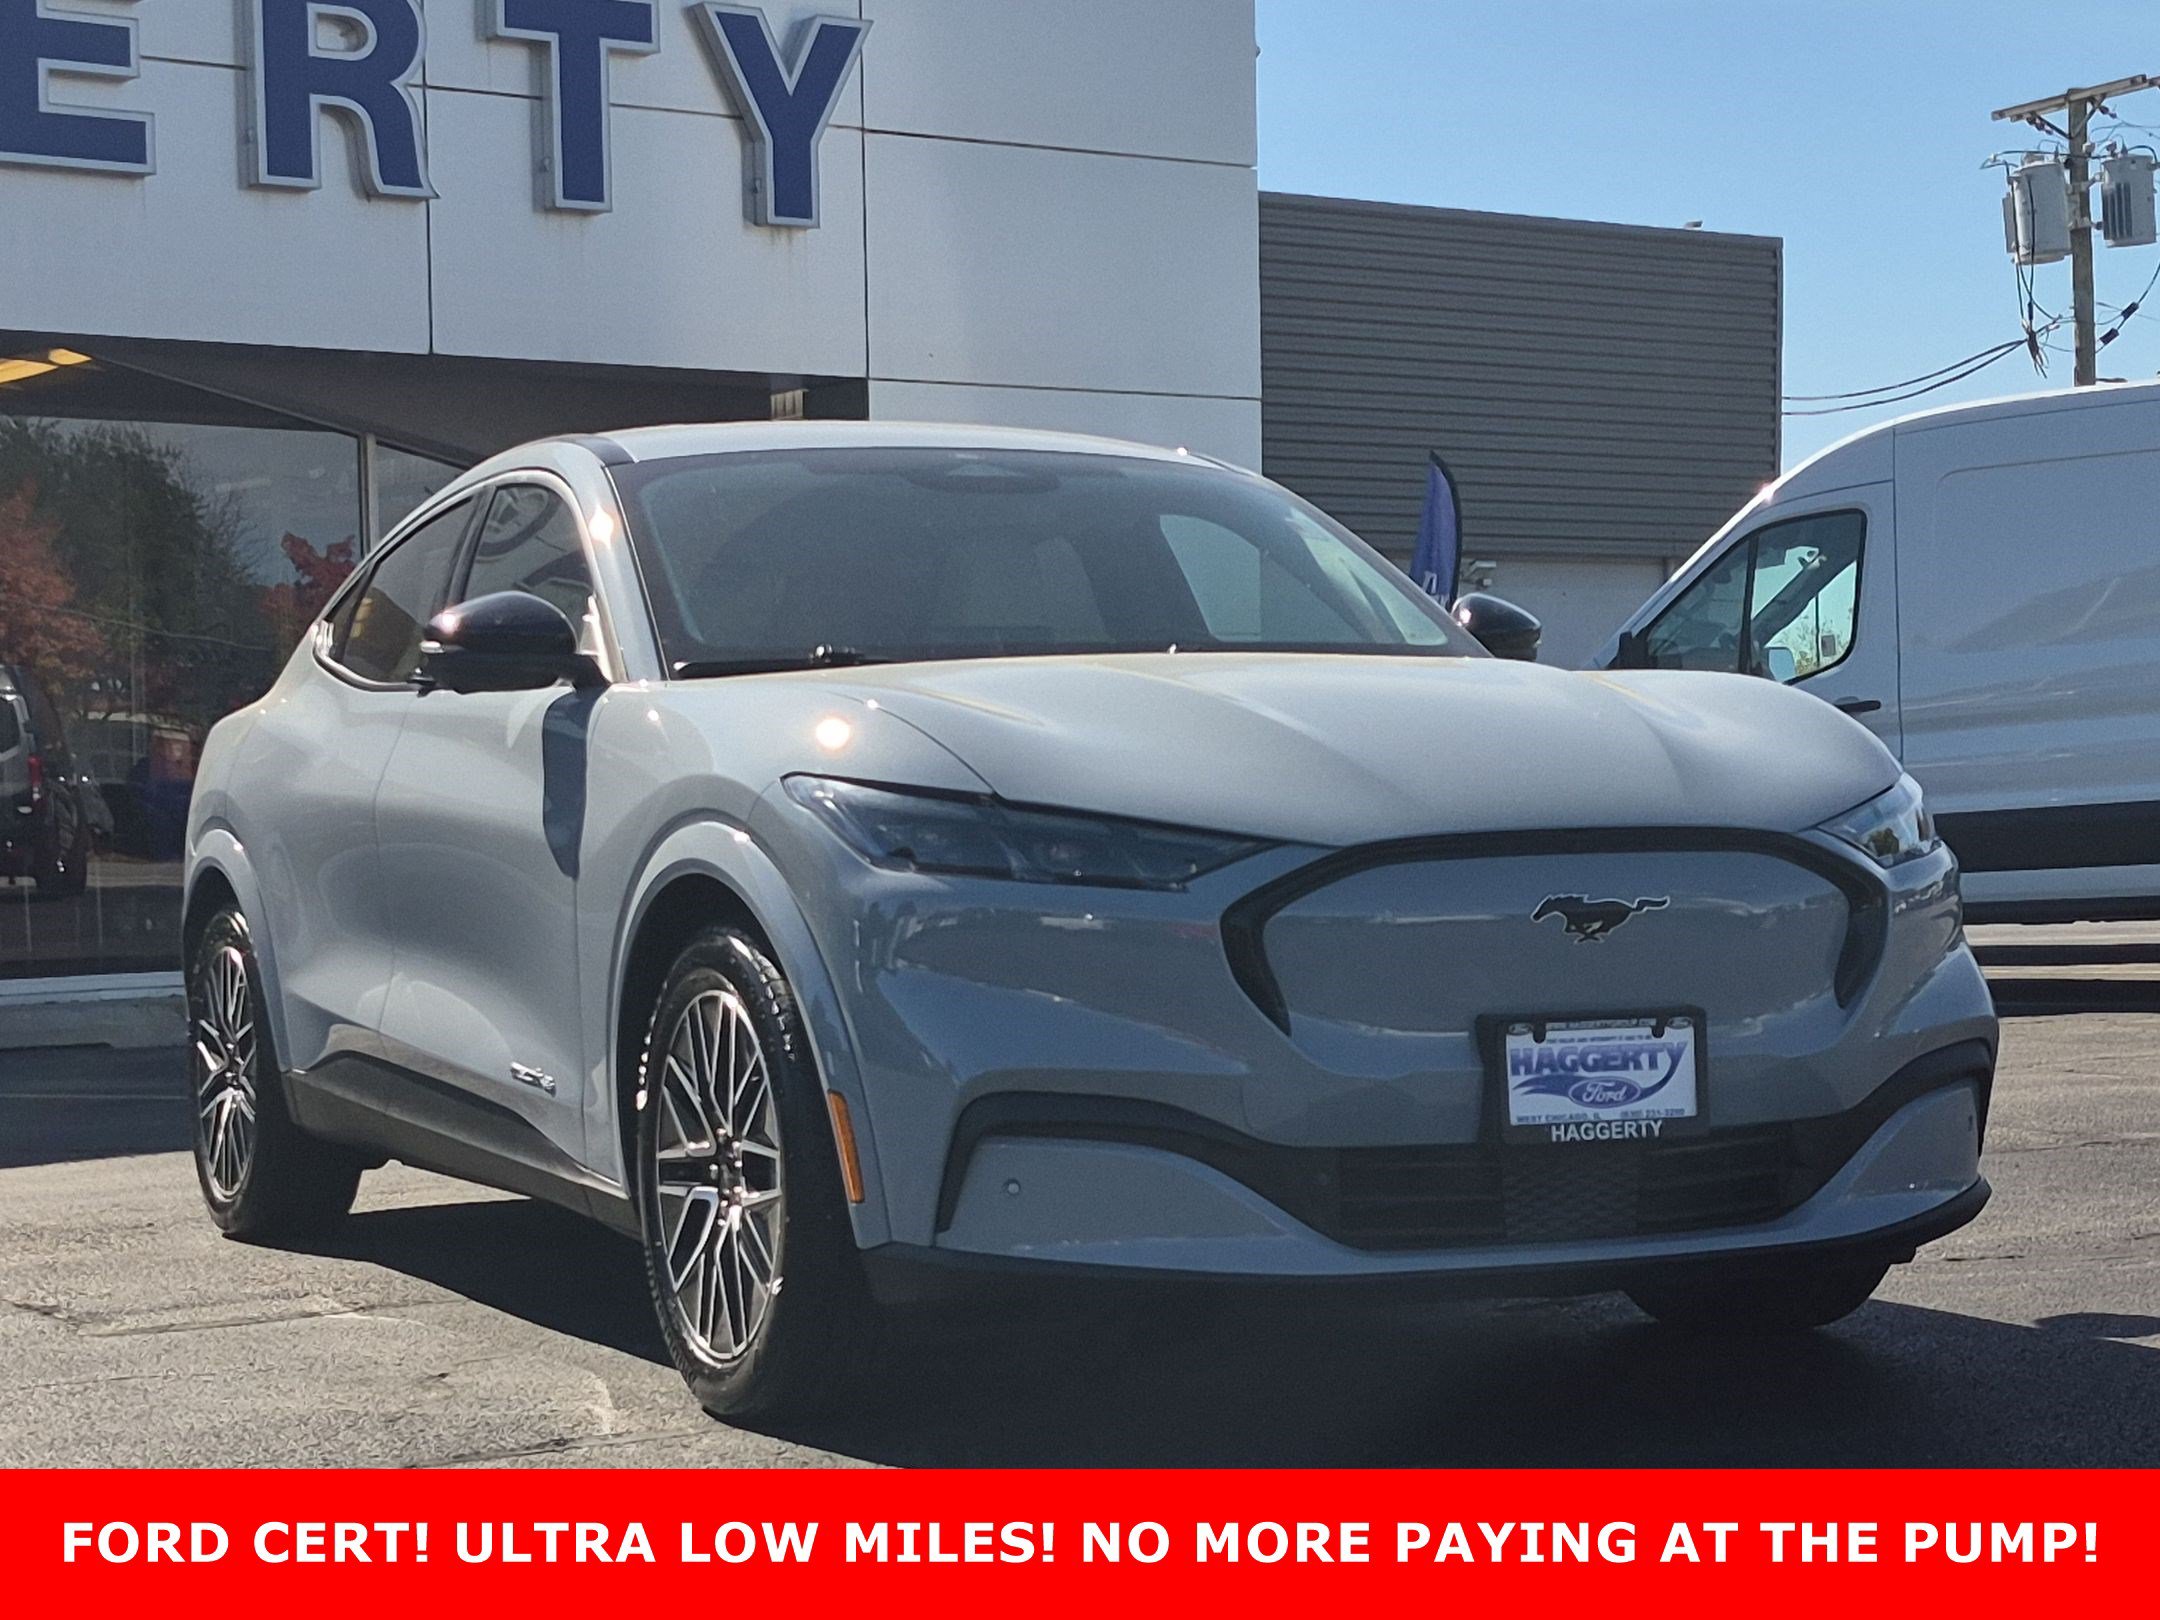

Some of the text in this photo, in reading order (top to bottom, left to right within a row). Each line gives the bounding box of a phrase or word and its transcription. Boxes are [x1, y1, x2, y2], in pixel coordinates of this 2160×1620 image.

[1510, 1041, 1688, 1076] HAGGERTY
[1582, 1081, 1628, 1103] Ford
[1516, 1113, 1542, 1123] WEST
[1551, 1119, 1663, 1142] HAGGERTY
